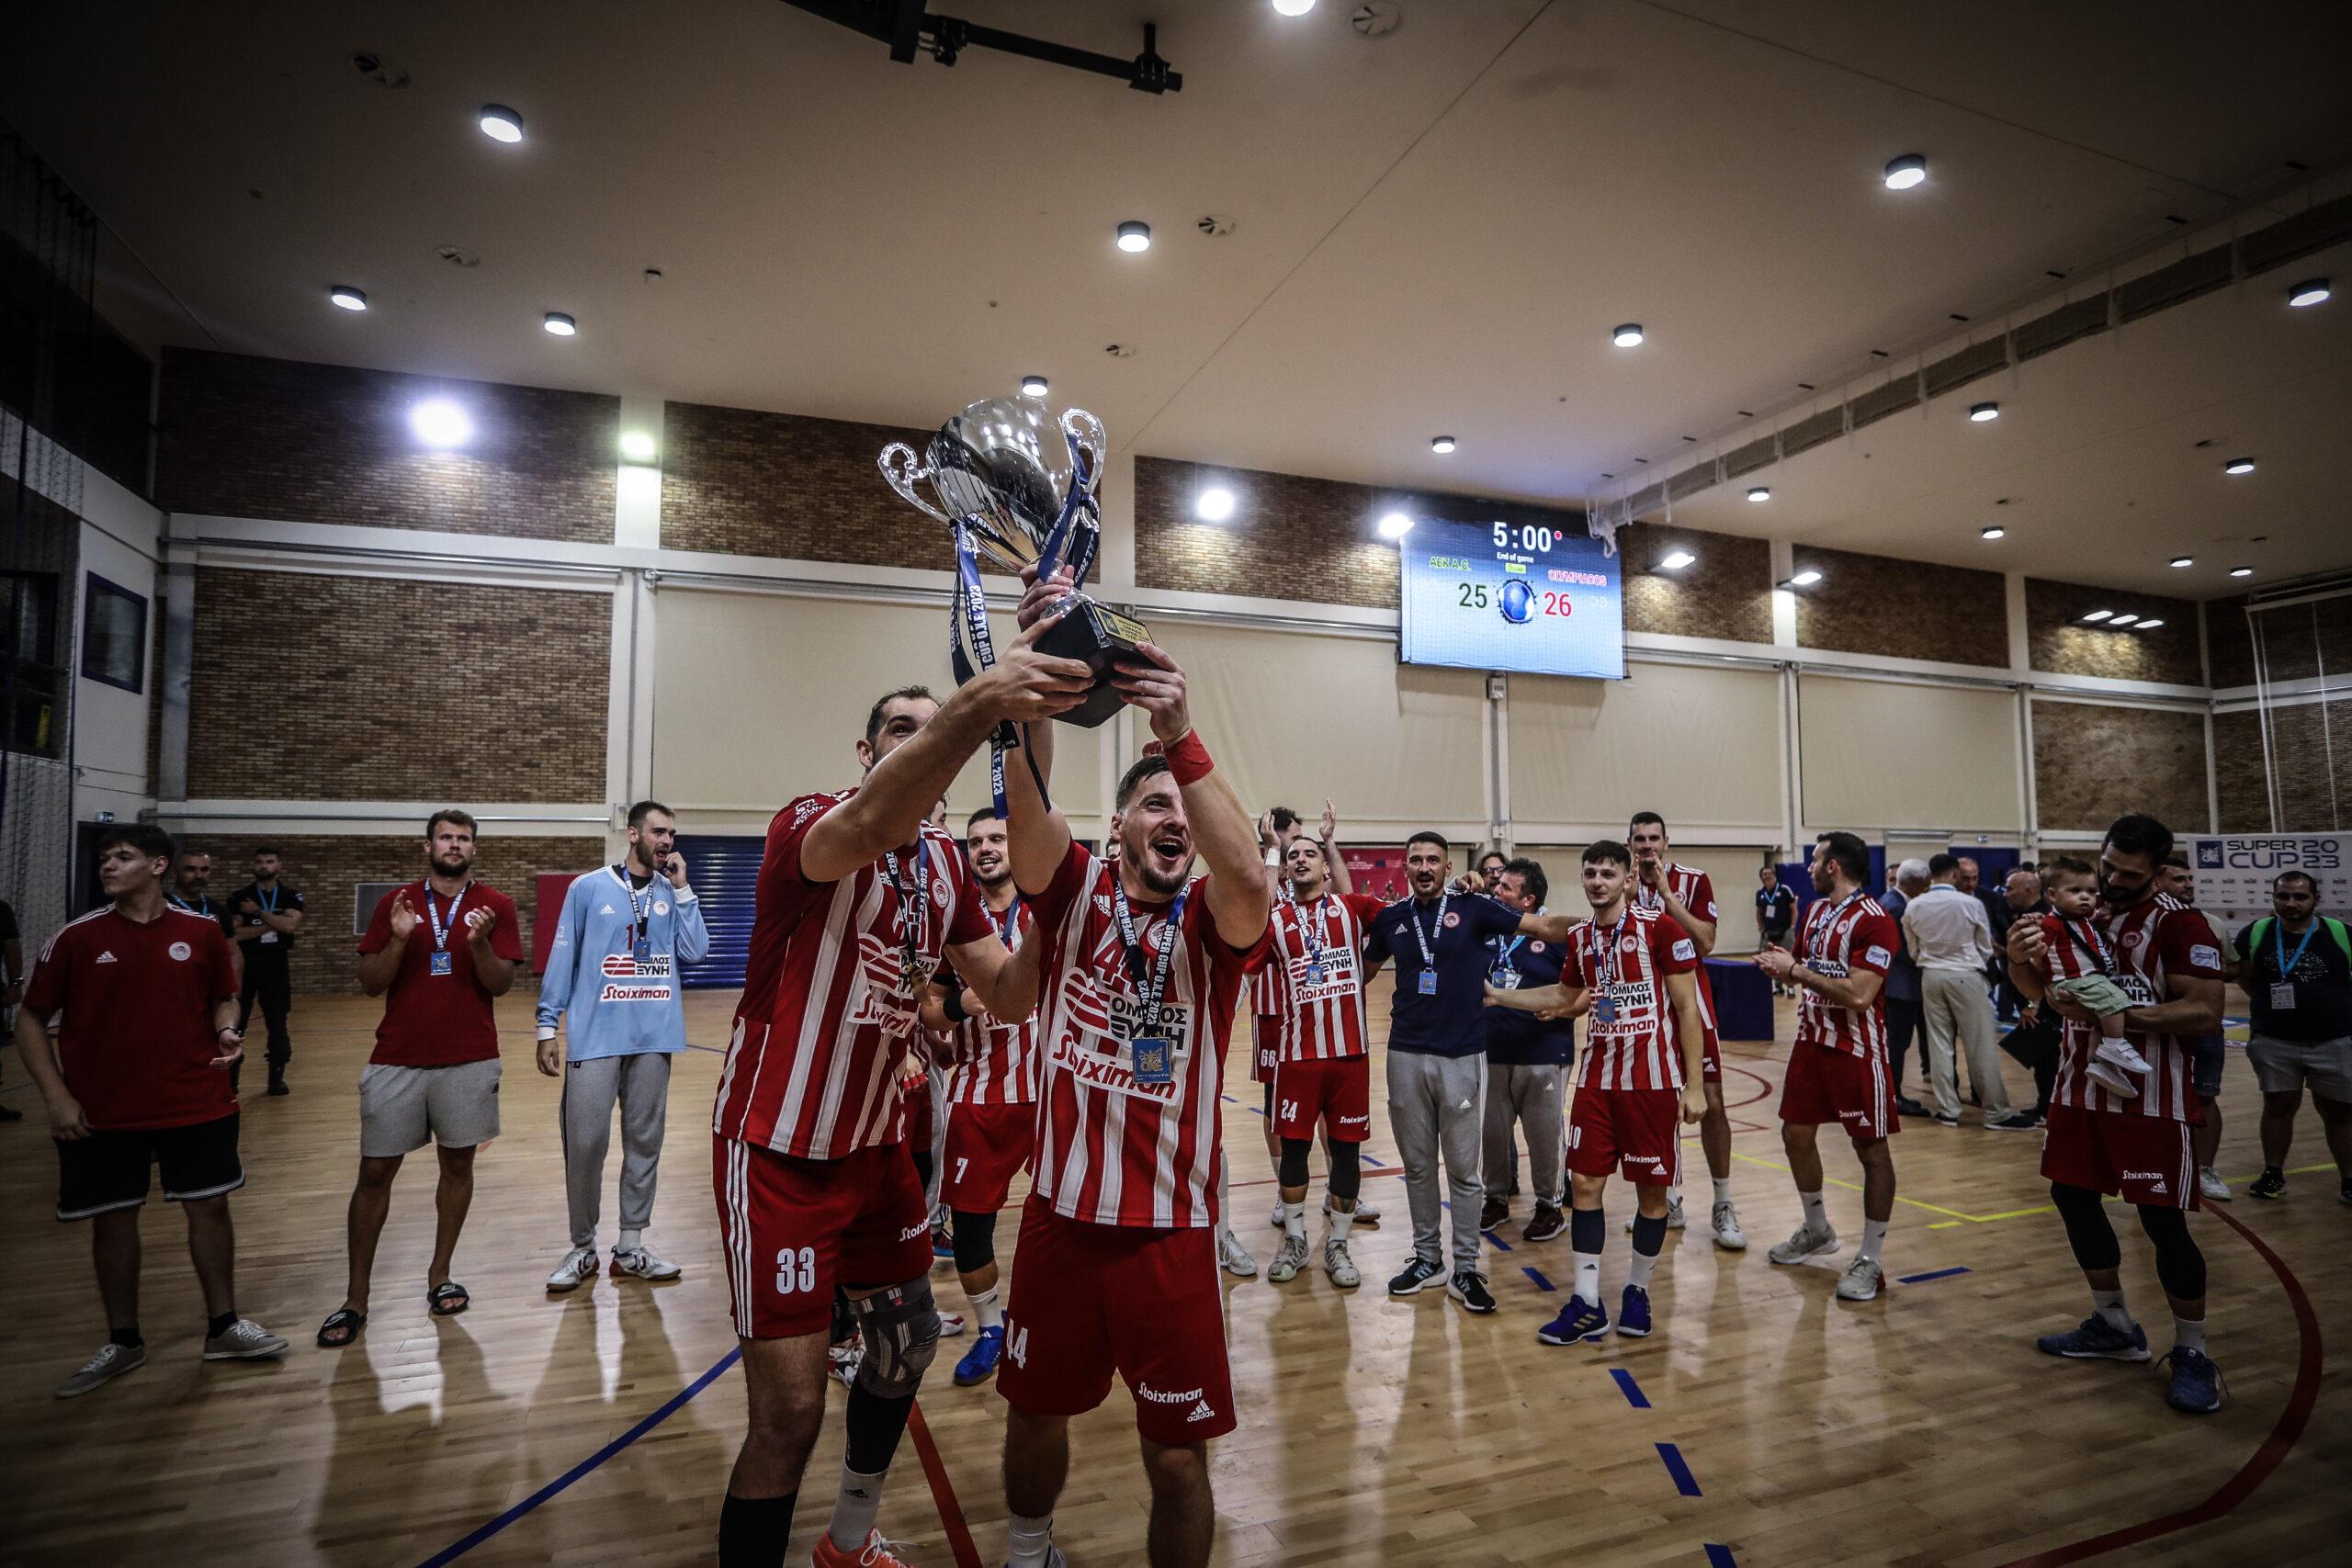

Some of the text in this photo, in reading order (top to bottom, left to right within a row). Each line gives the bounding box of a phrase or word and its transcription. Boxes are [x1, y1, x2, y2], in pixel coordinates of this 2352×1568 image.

[1493, 521, 1552, 552] 5:00
[1430, 556, 1449, 568] AEK
[1497, 551, 1509, 560] End
[1517, 555, 1534, 563] game
[969, 584, 984, 611] 2023
[1459, 582, 1487, 608] 25
[1544, 592, 1572, 617] 26
[978, 640, 993, 663] CUP
[992, 766, 1004, 795] 2023
[2227, 840, 2297, 851] SUPER
[2301, 840, 2339, 853] 20
[886, 852, 899, 875] 2023
[2229, 852, 2299, 869] CUP
[2303, 855, 2340, 869] 23
[920, 867, 928, 888] 2023
[1116, 899, 1129, 918] CUP
[1121, 917, 1136, 946] SUPER
[1159, 924, 1176, 953] SUPER
[637, 956, 670, 964] ΙΛΟΣ
[1156, 954, 1169, 975] CUP
[1319, 949, 1351, 962] ΟΜΙΛΟΣ
[637, 965, 670, 976] ΞΥΝΗ
[603, 984, 670, 999] Stoiximan
[1295, 982, 1356, 1002] Stoiximan
[1611, 983, 1651, 995] ΟΜΙΛΟΣ
[1112, 997, 1188, 1025] ΟΜΟΣ
[1613, 993, 1653, 1008] ΞΥΝΗ
[1146, 999, 1160, 1025] 2023
[1111, 1014, 1185, 1053] ΞΥΗ
[1590, 1019, 1656, 1034] Stoiximan
[1052, 1033, 1177, 1100] Siximan
[1261, 1049, 1276, 1067] 66
[1281, 1100, 1298, 1122] 24
[1623, 1153, 1661, 1164] Stoiximan
[956, 1157, 968, 1184] 7
[2122, 1169, 2164, 1180] Stoiximan
[775, 1247, 816, 1294] 33
[1006, 1317, 1029, 1370] 44
[1138, 1382, 1203, 1404] Stoiximan
[1186, 1408, 1216, 1423] adidas
